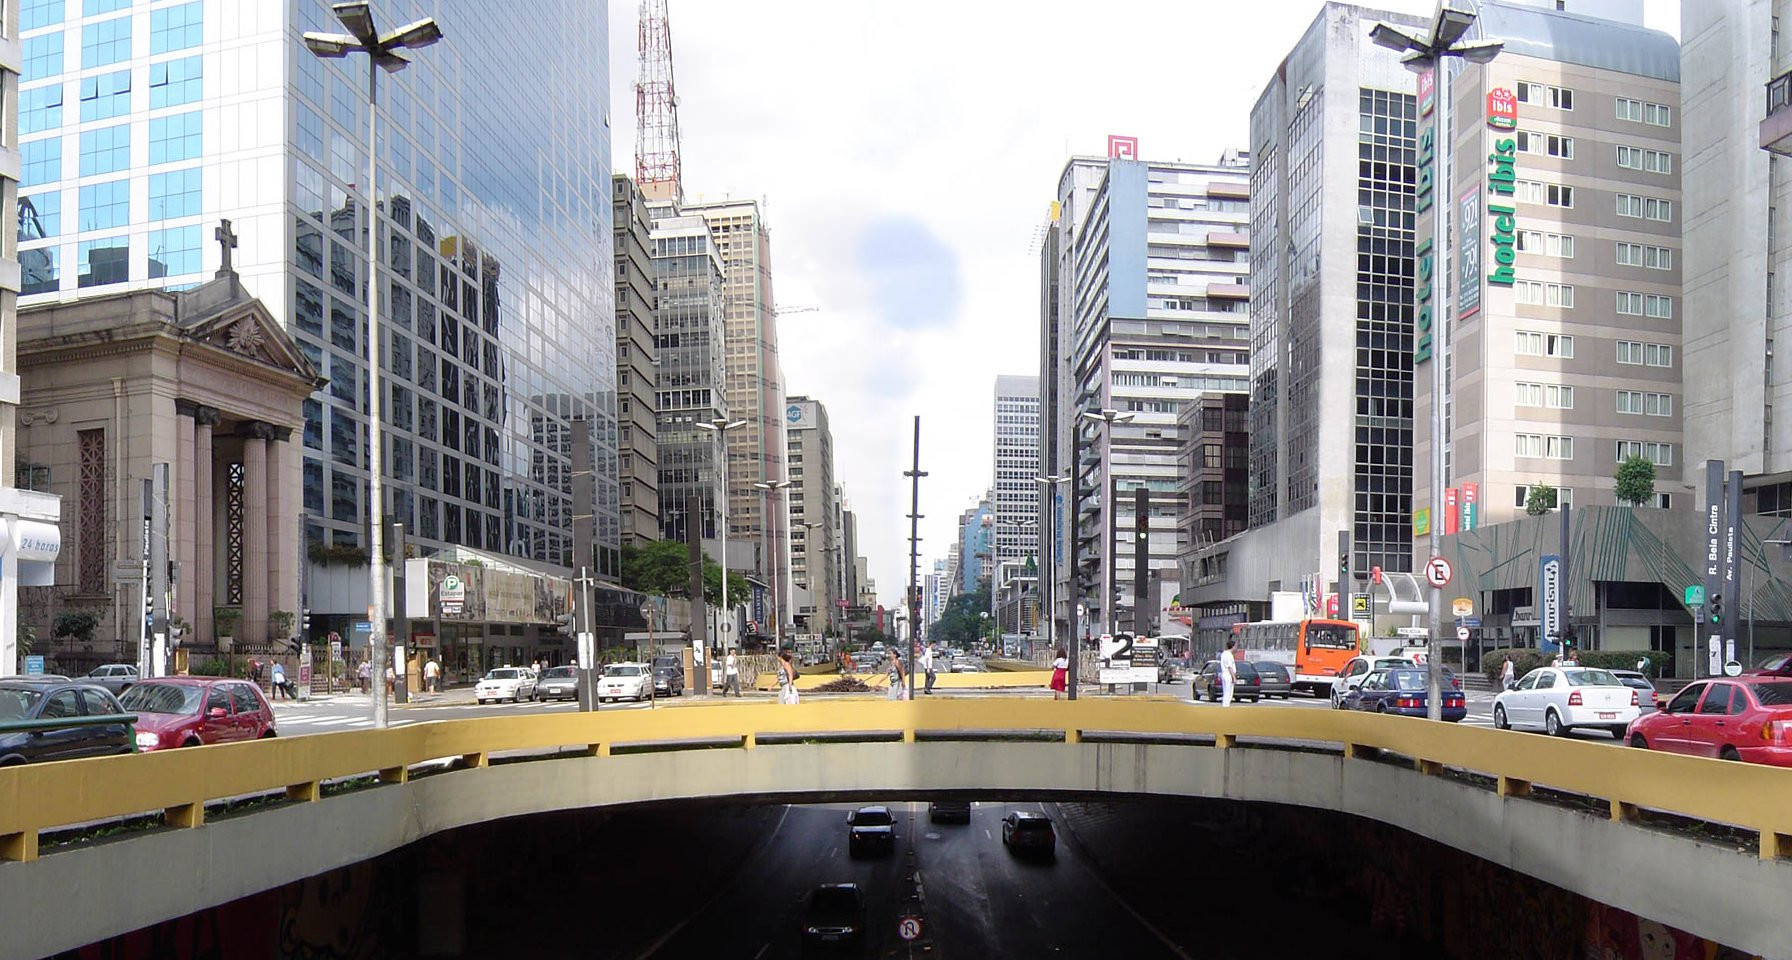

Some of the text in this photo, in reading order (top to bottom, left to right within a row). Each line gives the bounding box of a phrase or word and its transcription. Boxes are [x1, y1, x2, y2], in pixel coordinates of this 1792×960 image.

[1421, 73, 1433, 93] ibis
[1493, 100, 1513, 113] ibis
[1416, 127, 1433, 214] ibis
[1488, 138, 1516, 285] hotel ibis
[1415, 239, 1432, 364] hotel
[21, 538, 59, 553] 24 horas
[1709, 505, 1718, 575] R. Bela Cintra
[447, 578, 457, 589] P
[1435, 564, 1445, 581] E
[1546, 571, 1556, 638] banrisul
[1112, 635, 1134, 660] 2
